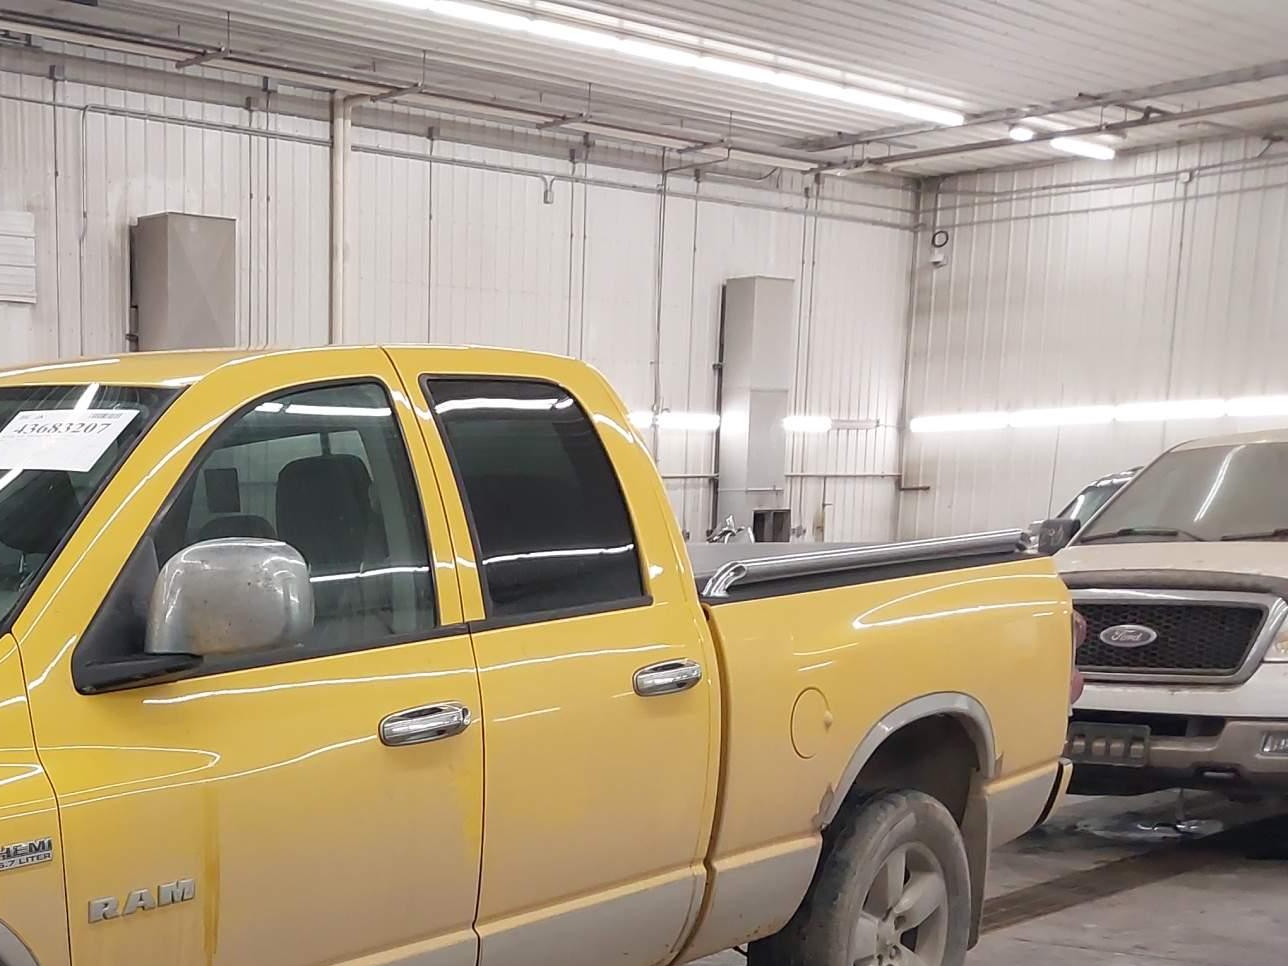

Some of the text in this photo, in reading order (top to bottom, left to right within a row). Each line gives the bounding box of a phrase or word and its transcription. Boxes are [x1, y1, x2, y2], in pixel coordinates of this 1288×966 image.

[14, 422, 112, 434] 43683207
[1112, 629, 1143, 641] Ford
[18, 852, 51, 865] LITER
[88, 878, 196, 924] RAM
